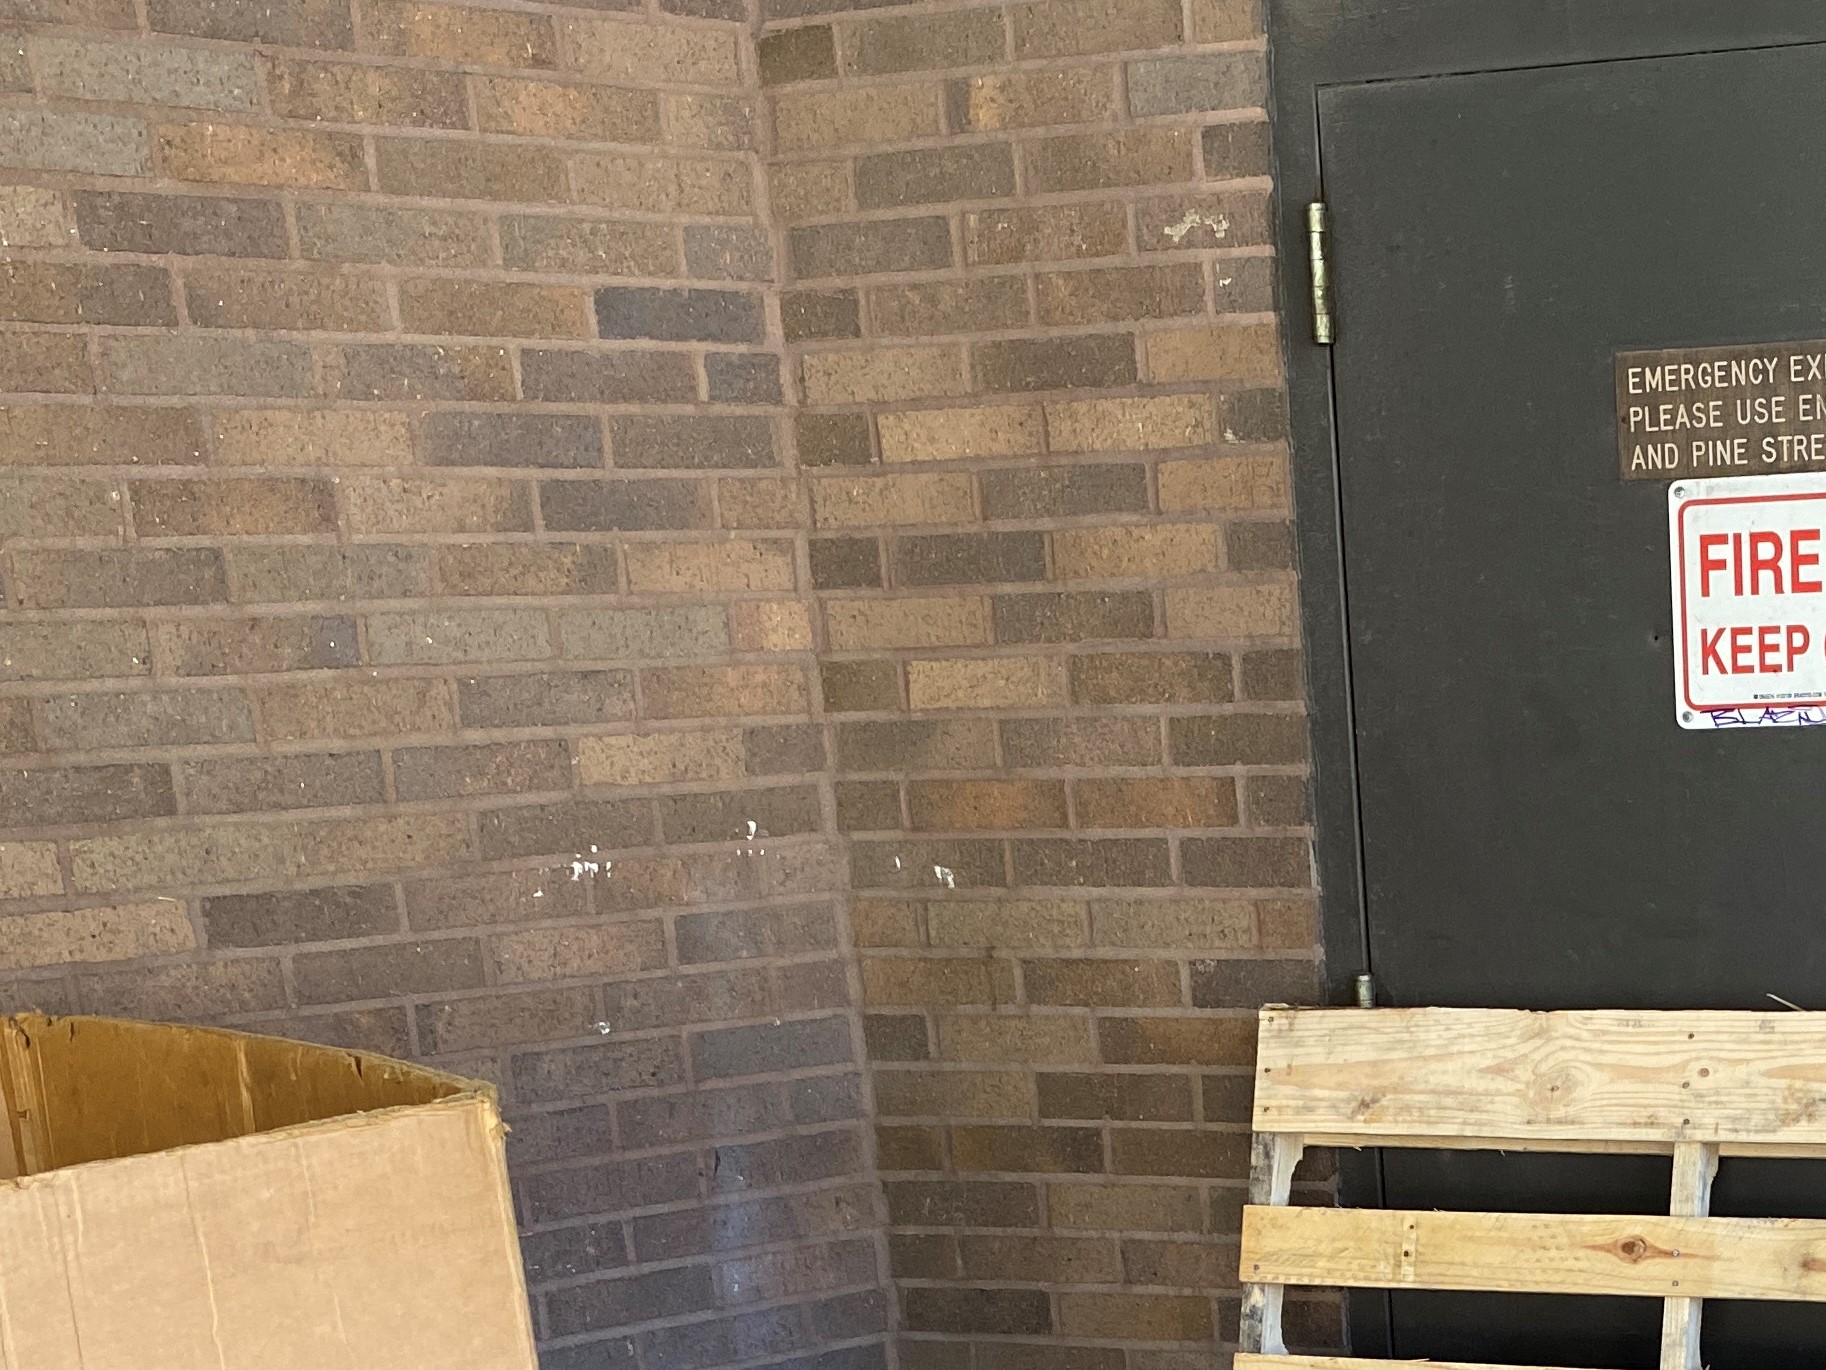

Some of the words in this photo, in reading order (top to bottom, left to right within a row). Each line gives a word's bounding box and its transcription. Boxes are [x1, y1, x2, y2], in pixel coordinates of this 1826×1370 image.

[1627, 357, 1778, 394] EMERGENCY
[1629, 400, 1724, 433] PLEASE
[1736, 396, 1786, 425] USE
[1631, 442, 1679, 471] AND
[1692, 438, 1749, 468] PINE
[1700, 528, 1823, 597] FIRE
[1700, 624, 1810, 675] KEEP
